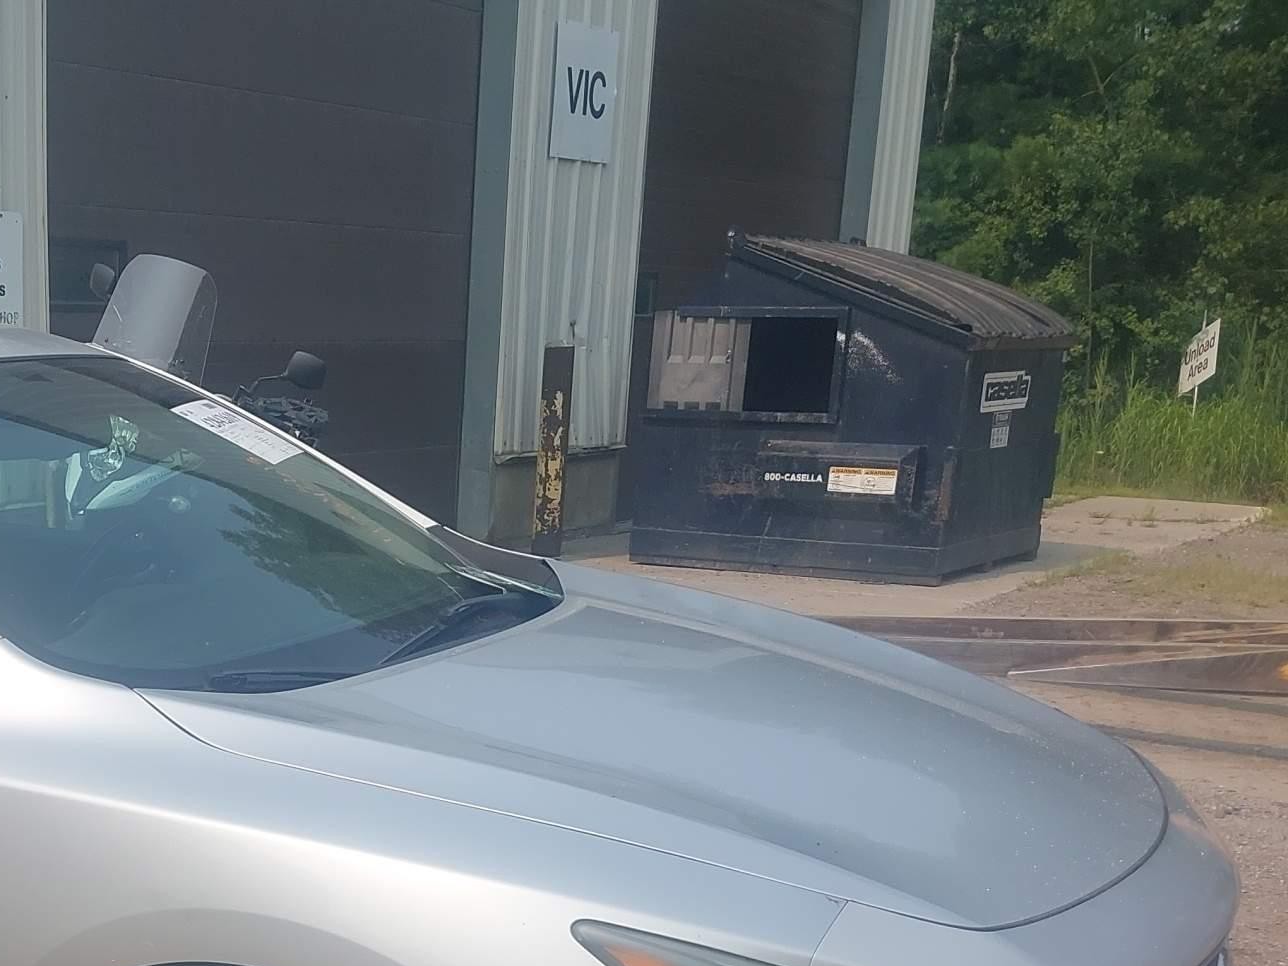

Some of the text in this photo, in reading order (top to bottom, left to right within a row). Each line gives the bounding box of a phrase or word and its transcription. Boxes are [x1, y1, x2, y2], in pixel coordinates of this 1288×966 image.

[567, 66, 607, 119] VIC
[1184, 331, 1217, 366] Unload
[1187, 357, 1209, 382] Area
[764, 472, 823, 483] 800-CASELLA
